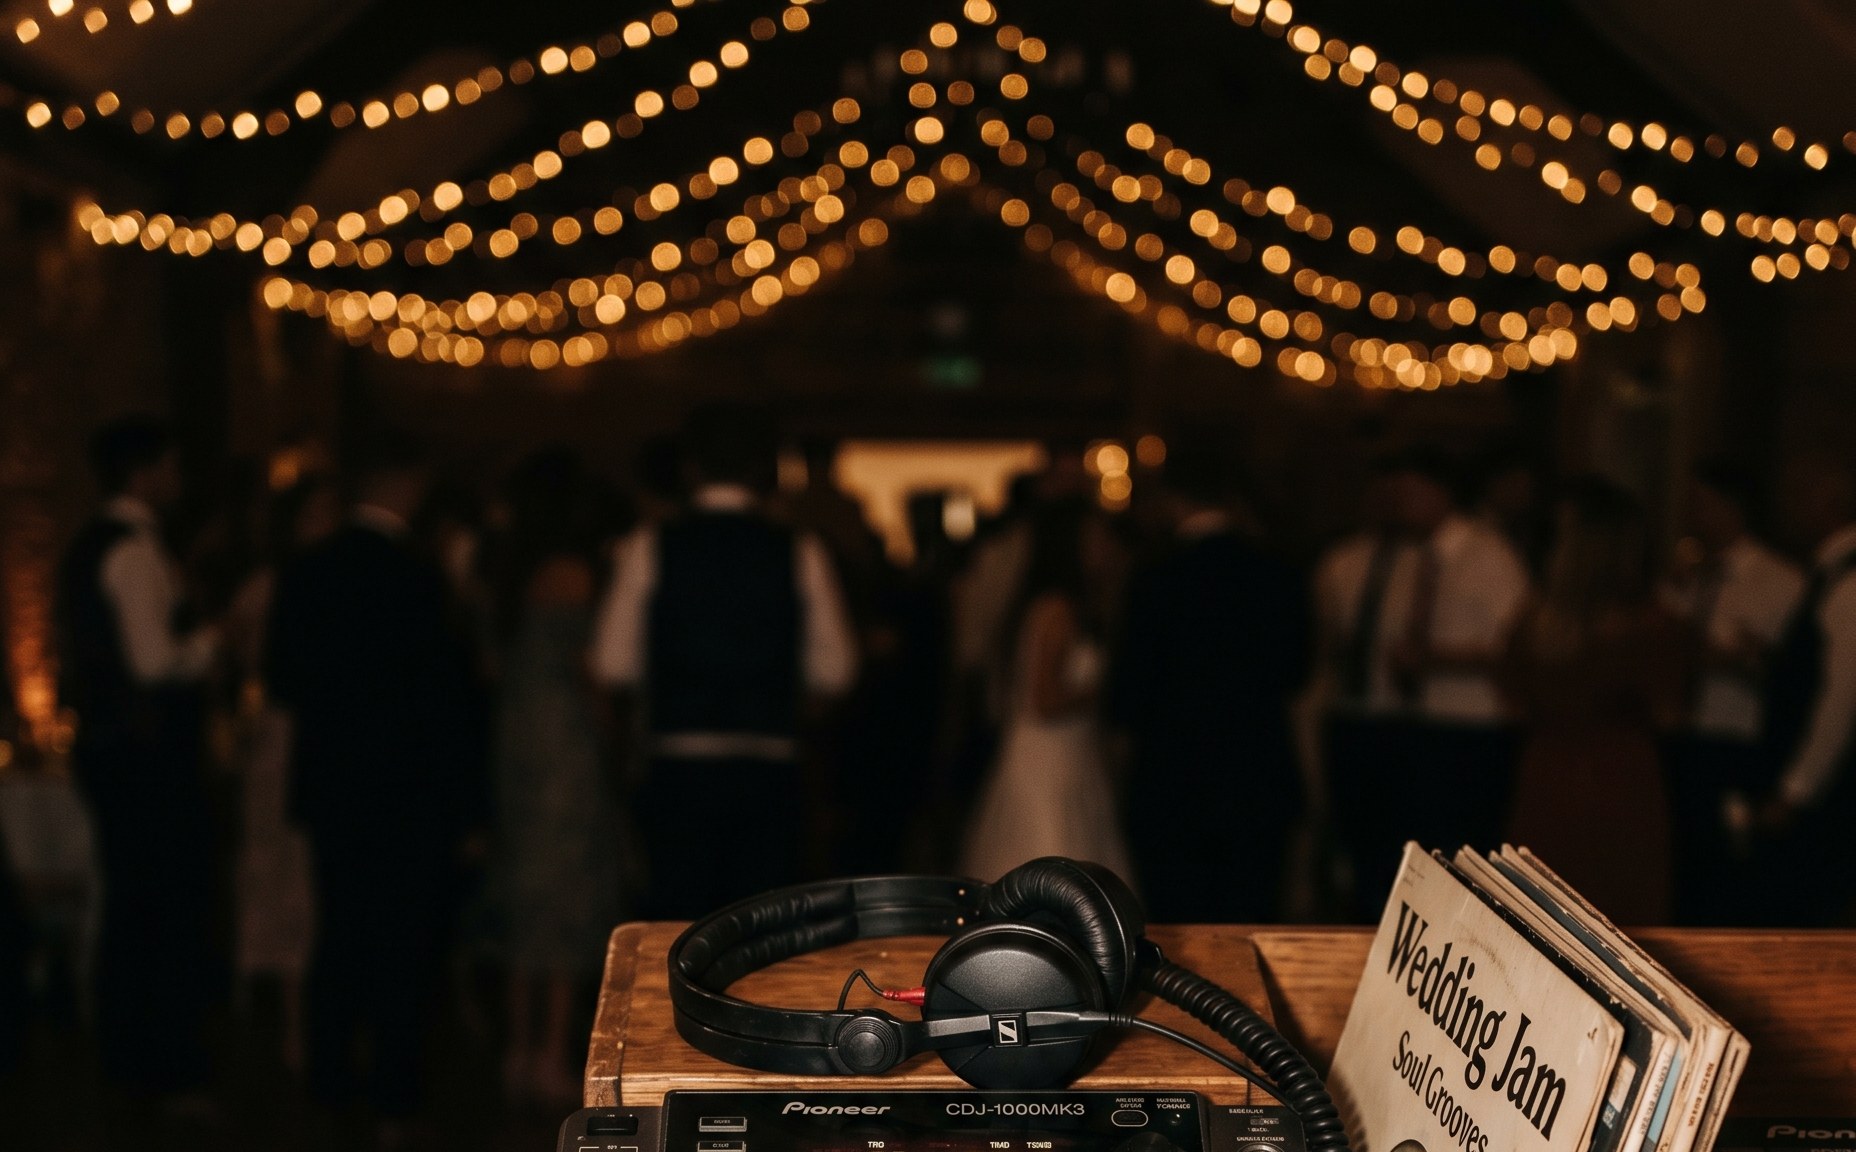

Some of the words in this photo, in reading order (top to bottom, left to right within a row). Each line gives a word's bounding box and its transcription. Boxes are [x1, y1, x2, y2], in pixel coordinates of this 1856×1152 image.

[1386, 900, 1506, 1090] Wedding
[1491, 1013, 1567, 1142] Jam
[1392, 1030, 1432, 1096] Soul
[781, 1101, 891, 1115] Pioneer
[945, 1103, 1085, 1116] CDJ-1000MK3
